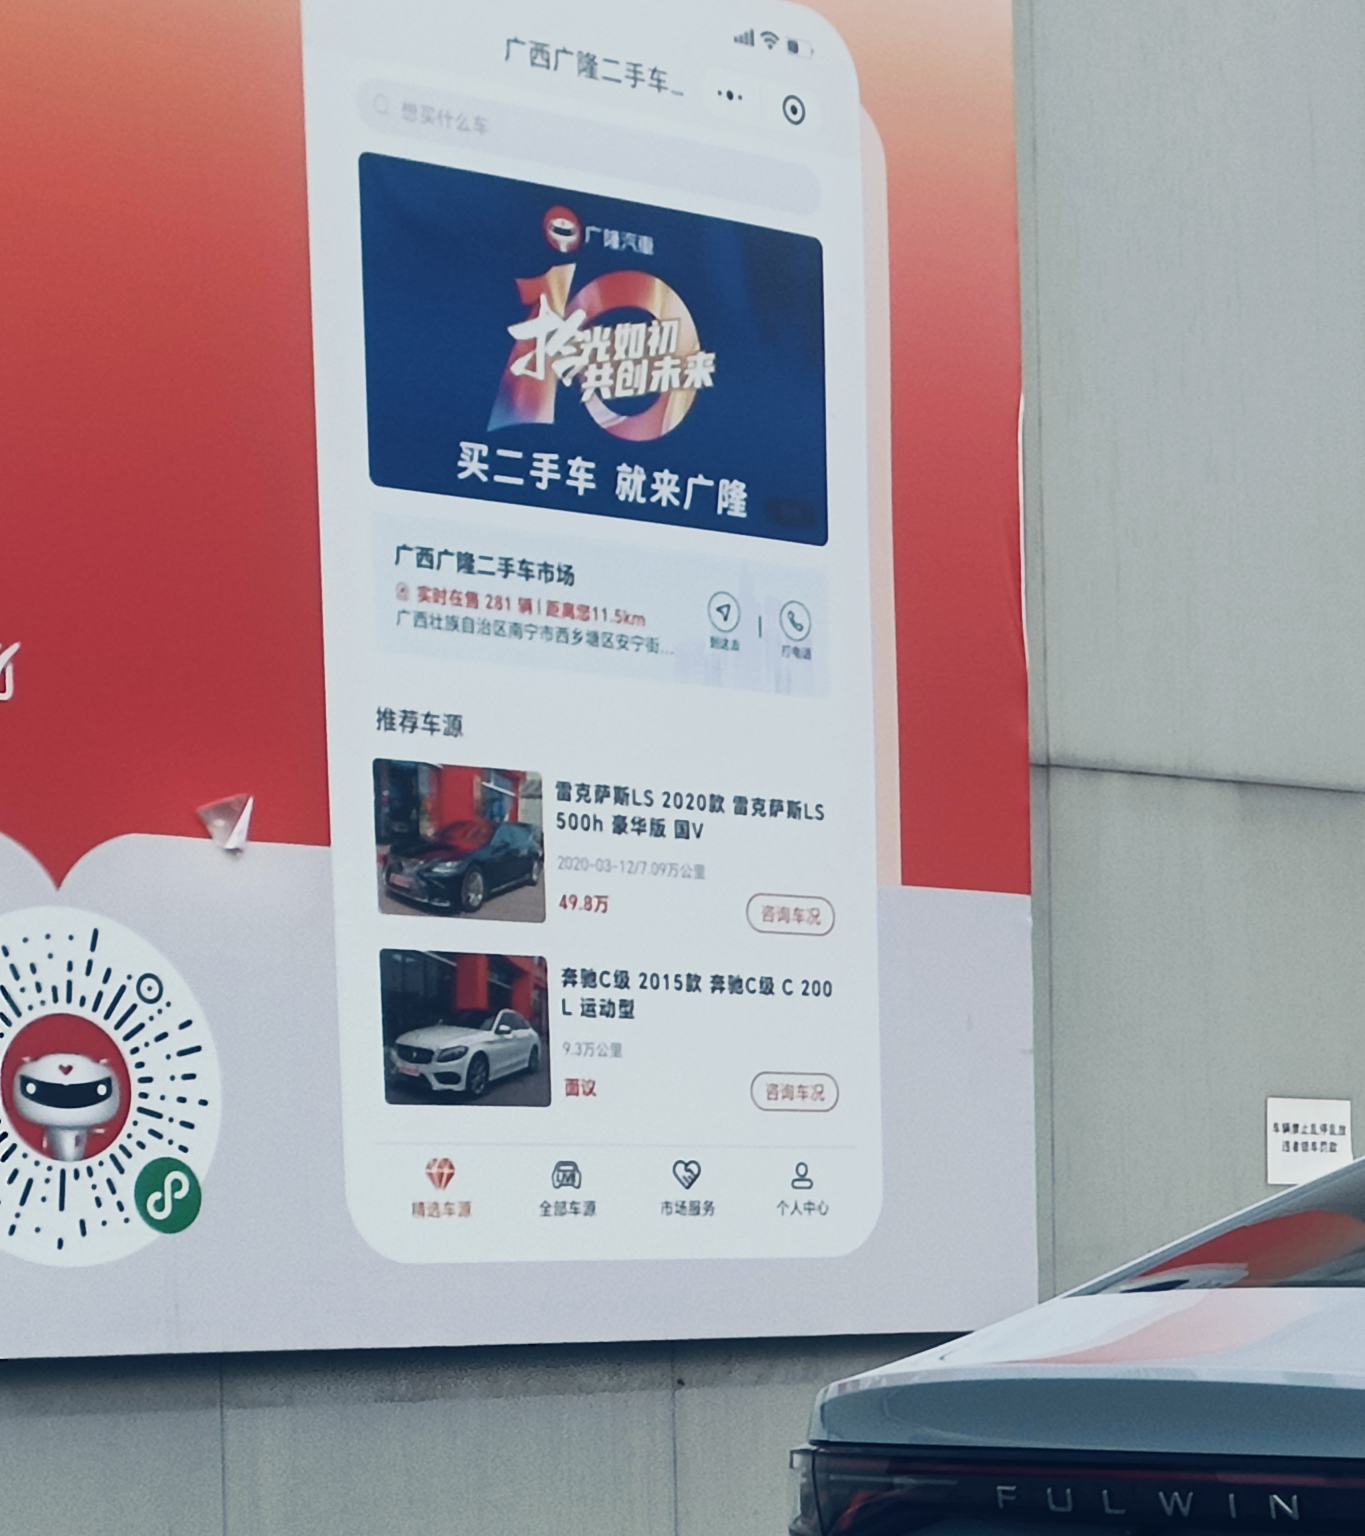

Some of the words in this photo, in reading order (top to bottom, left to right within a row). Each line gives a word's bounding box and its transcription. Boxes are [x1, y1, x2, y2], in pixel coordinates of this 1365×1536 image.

[401, 101, 488, 134] 想买什么车
[581, 350, 716, 402] 共创未来
[457, 441, 596, 496] 买二手车
[615, 462, 748, 518] 就来广隆
[394, 544, 576, 587] 广西广隆二手车市场
[417, 585, 479, 610] 实时在售
[484, 593, 512, 612] 281
[376, 706, 463, 738] 推荐车源
[555, 781, 655, 808] 雷克萨斯LS
[661, 790, 725, 814] 2020款
[733, 795, 826, 821] 雷克萨斯LS
[556, 812, 604, 833] 500h
[611, 814, 667, 839] 豪华版
[674, 819, 704, 840] 国V
[558, 894, 609, 914] 49.8万
[762, 904, 822, 926] 咨询车况
[561, 967, 632, 991] 奔驰C级
[638, 972, 702, 994] 2015款
[709, 974, 776, 997] 奔驰C级
[782, 978, 795, 996] C
[801, 979, 833, 998] 200
[561, 998, 573, 1017] L
[580, 997, 636, 1020] 运动型
[562, 1041, 624, 1059] 9.3万公里
[564, 1078, 597, 1098] 面议
[766, 1082, 826, 1103] 咨询车况
[539, 1200, 597, 1217] 全部车源
[660, 1200, 716, 1217] 市场服务
[776, 1199, 830, 1216] 个人中心
[996, 1485, 1300, 1521] FULWIN
